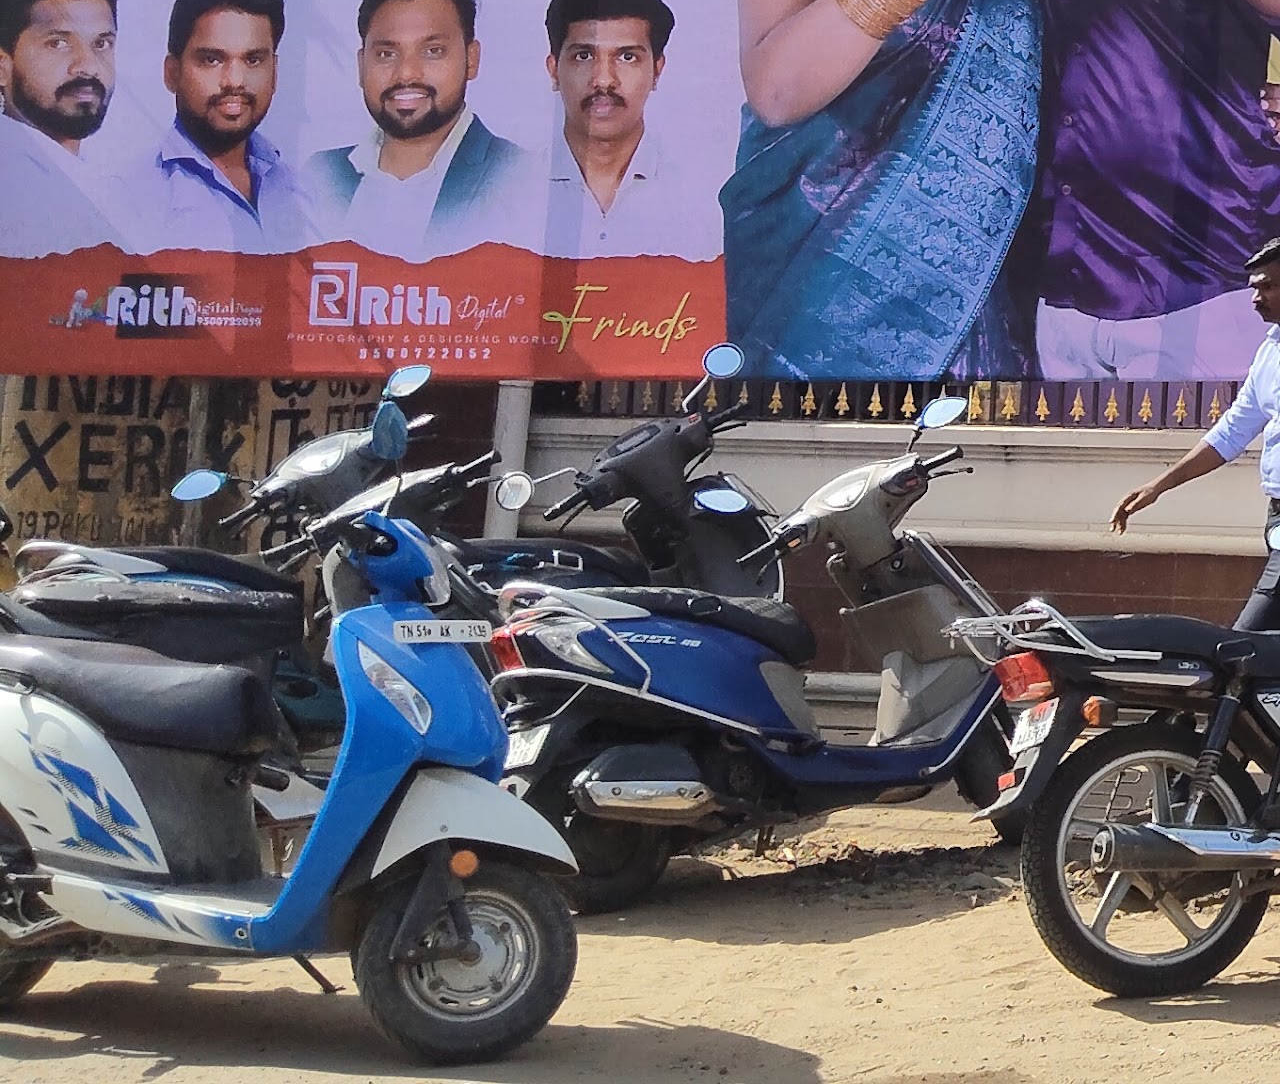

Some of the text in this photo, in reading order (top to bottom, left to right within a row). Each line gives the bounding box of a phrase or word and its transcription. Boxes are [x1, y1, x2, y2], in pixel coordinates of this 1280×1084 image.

[106, 284, 197, 327] Rith
[361, 284, 513, 331] Rith Digital
[543, 283, 697, 355] Frinds
[287, 333, 395, 345] PHOTOGRAPHY
[508, 335, 558, 346] WORLD
